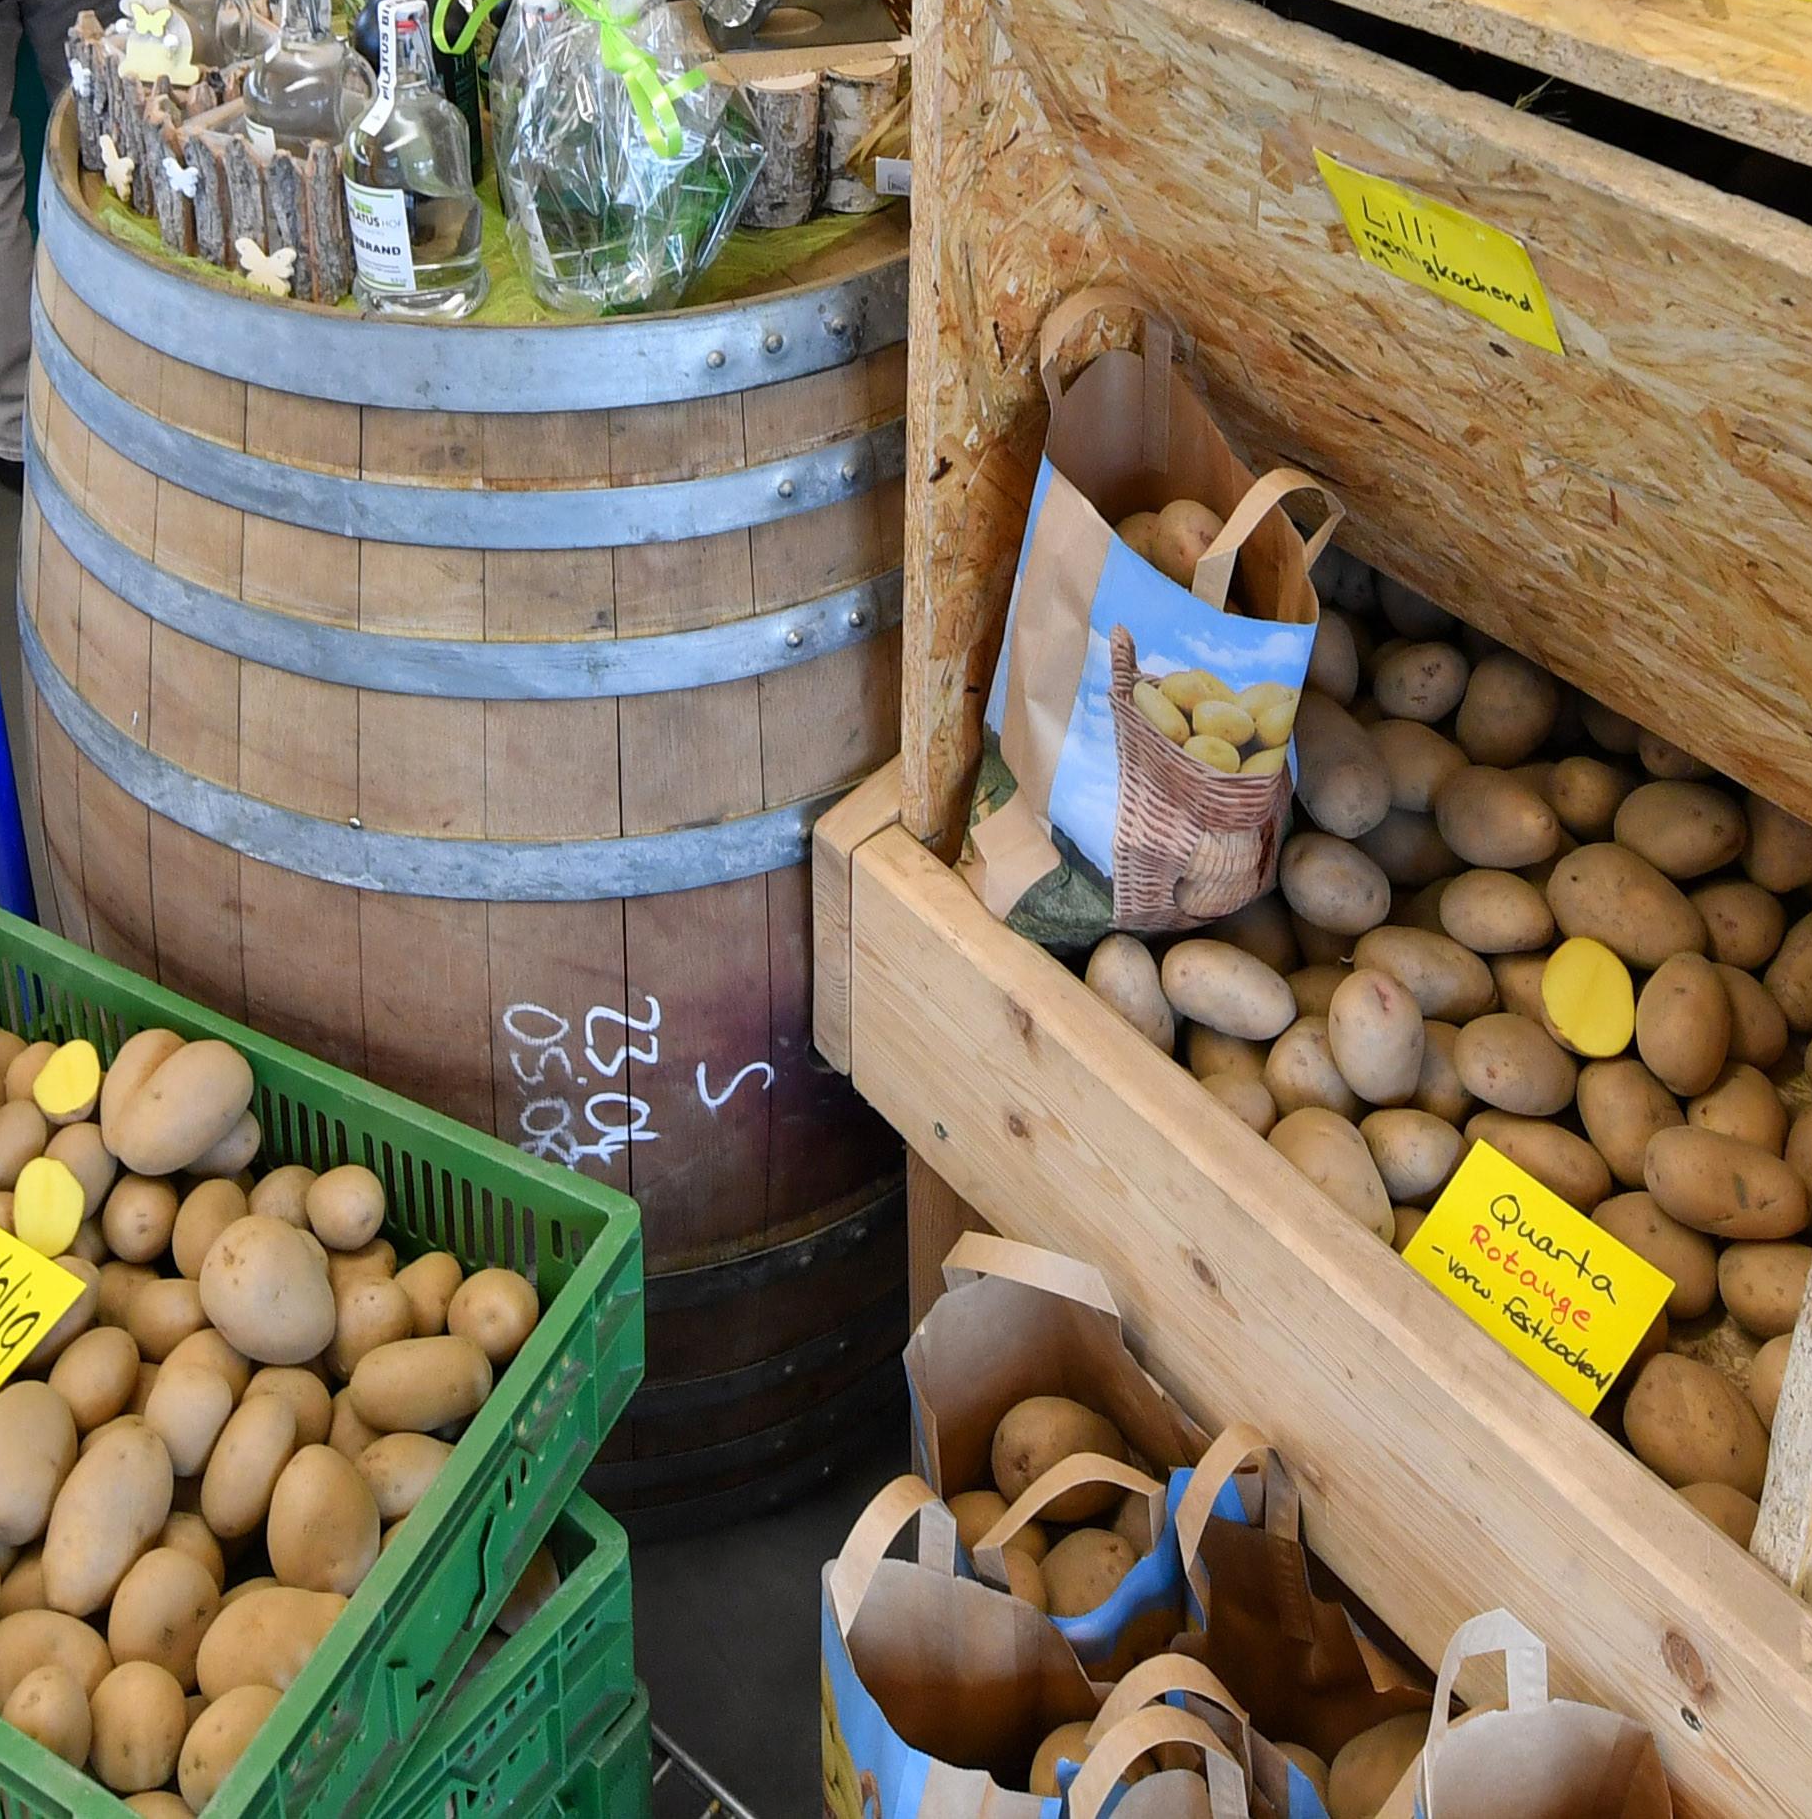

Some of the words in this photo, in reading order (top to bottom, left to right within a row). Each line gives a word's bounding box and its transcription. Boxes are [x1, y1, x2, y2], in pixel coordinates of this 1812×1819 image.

[1361, 194, 1437, 249] Lilli
[1469, 1224, 1592, 1332] Rotauge
[1489, 1193, 1617, 1306] Quarta
